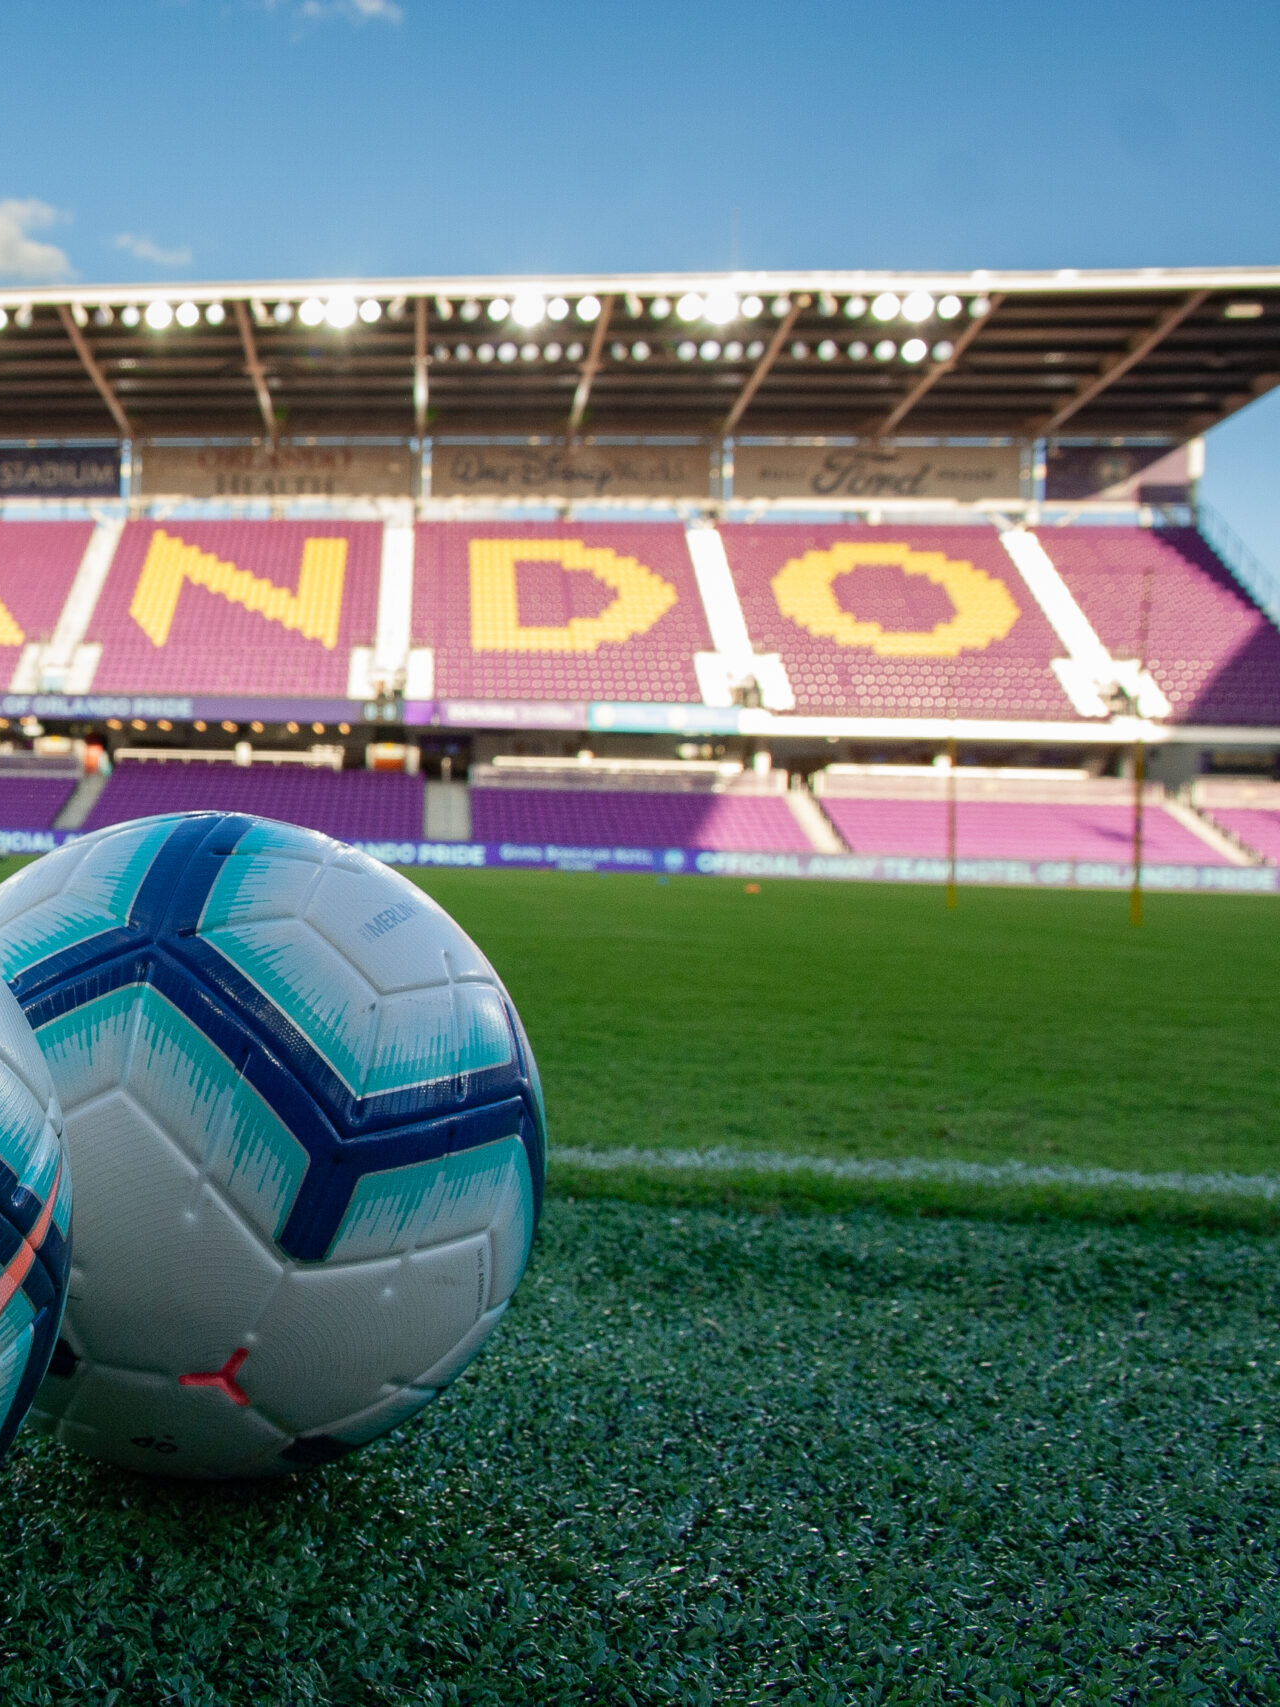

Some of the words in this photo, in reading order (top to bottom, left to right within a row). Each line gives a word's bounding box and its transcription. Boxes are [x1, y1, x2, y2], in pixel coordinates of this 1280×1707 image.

[812, 451, 933, 495] Ford
[3, 694, 32, 715] OF
[33, 694, 131, 716] ORLANDO
[133, 696, 194, 717] PRIDE
[418, 844, 486, 866] PRIDE
[696, 852, 802, 875] OFFICIAL
[806, 854, 876, 878] AWAY
[880, 857, 949, 880] TEAM
[1036, 862, 1072, 884] OF
[1073, 863, 1199, 888] ORLANDO
[1200, 867, 1274, 890] PRIDE
[364, 901, 418, 937] MERLIN
